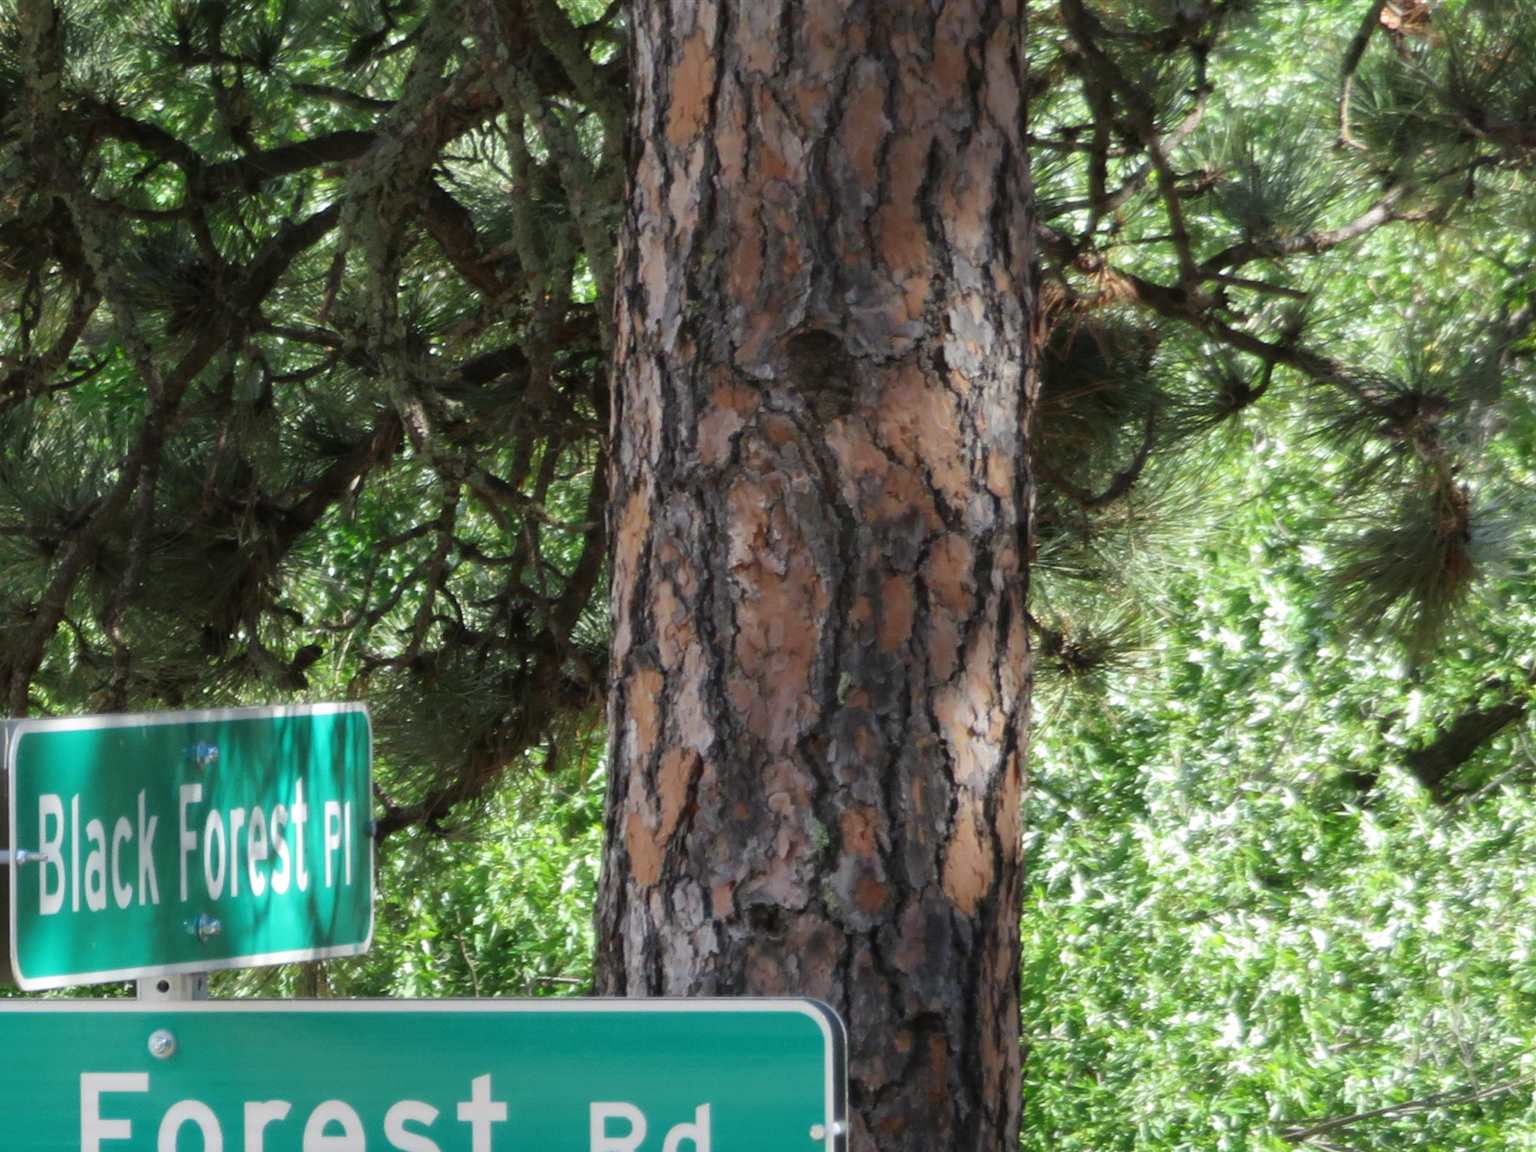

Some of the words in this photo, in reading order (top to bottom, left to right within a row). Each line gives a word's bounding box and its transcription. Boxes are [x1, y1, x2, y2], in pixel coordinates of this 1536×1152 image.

[39, 788, 160, 916] Black
[179, 777, 309, 902] Forest
[324, 800, 352, 888] Pl
